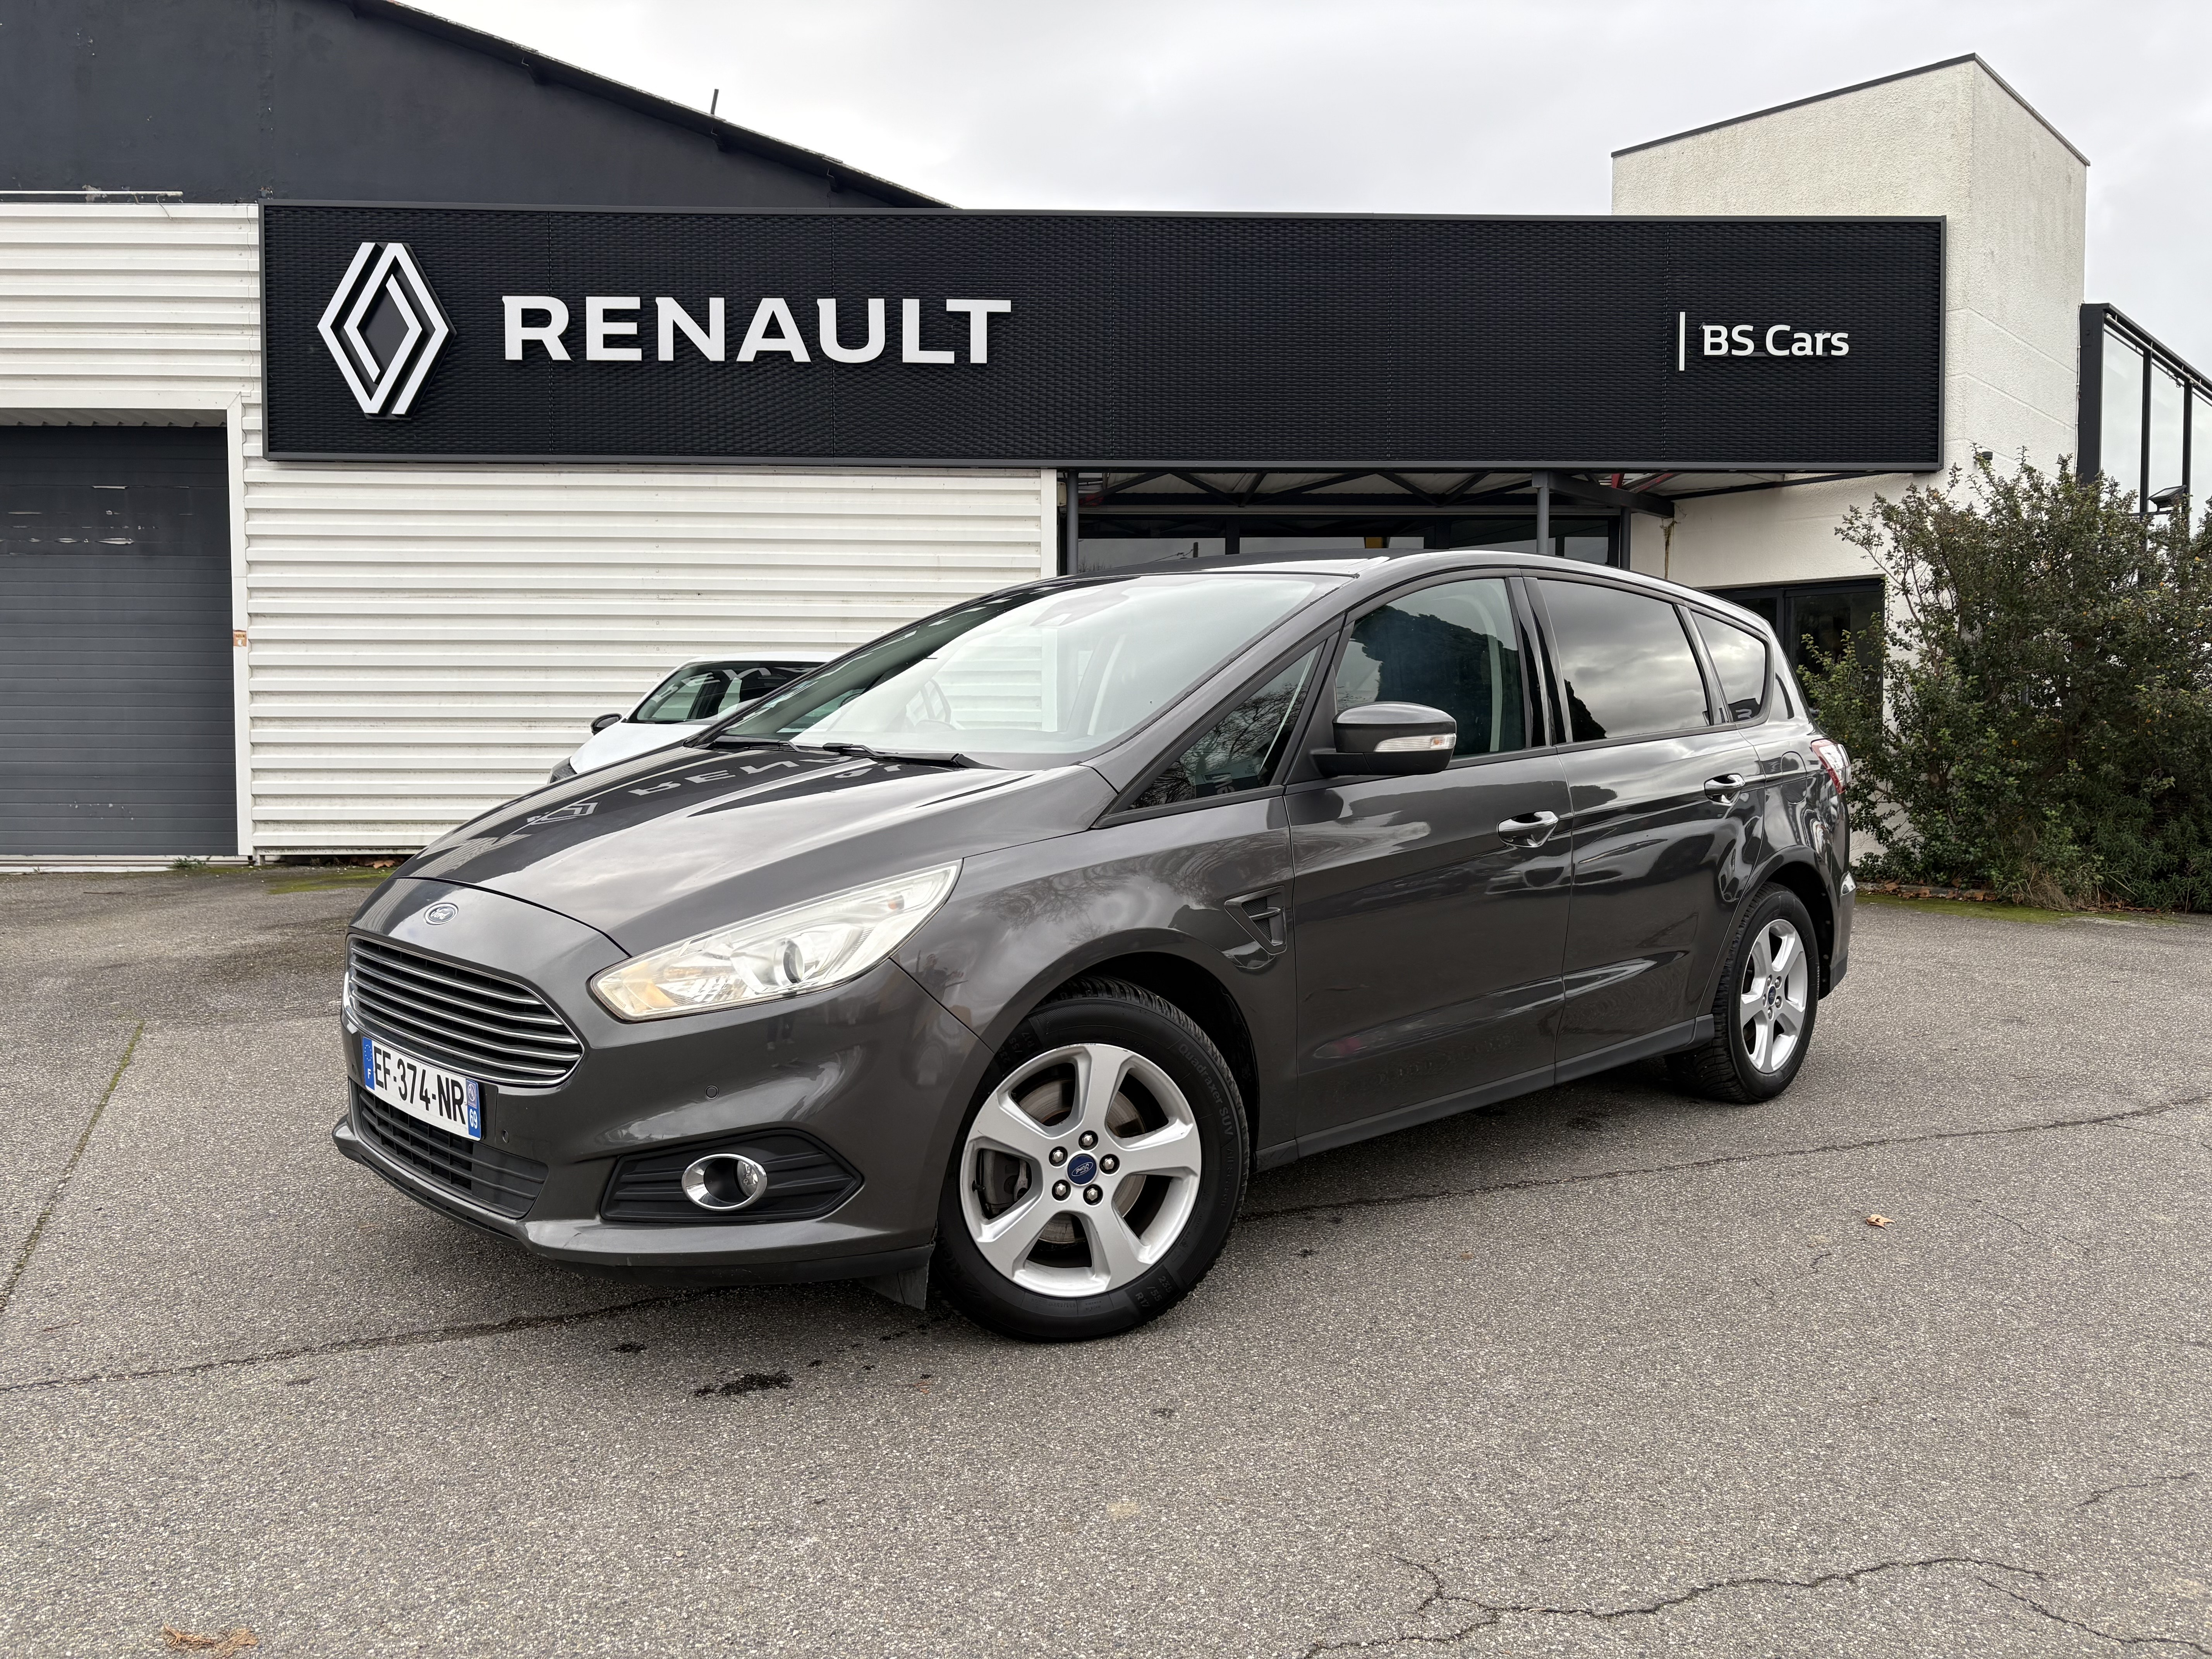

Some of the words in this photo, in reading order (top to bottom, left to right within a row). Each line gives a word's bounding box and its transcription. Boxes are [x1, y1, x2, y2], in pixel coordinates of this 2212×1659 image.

[502, 295, 1011, 364] RENAULT
[1702, 325, 1755, 356] BS
[1765, 325, 1850, 356] Cars
[430, 907, 451, 920] Ford
[367, 1068, 371, 1079] F
[374, 1046, 466, 1125] EF-374-NR
[1178, 1043, 1223, 1104] Quadraxer
[1219, 1106, 1235, 1136] SUV
[469, 1108, 478, 1129] 69
[1075, 1163, 1090, 1175] Ford
[1135, 1292, 1151, 1307] R17
